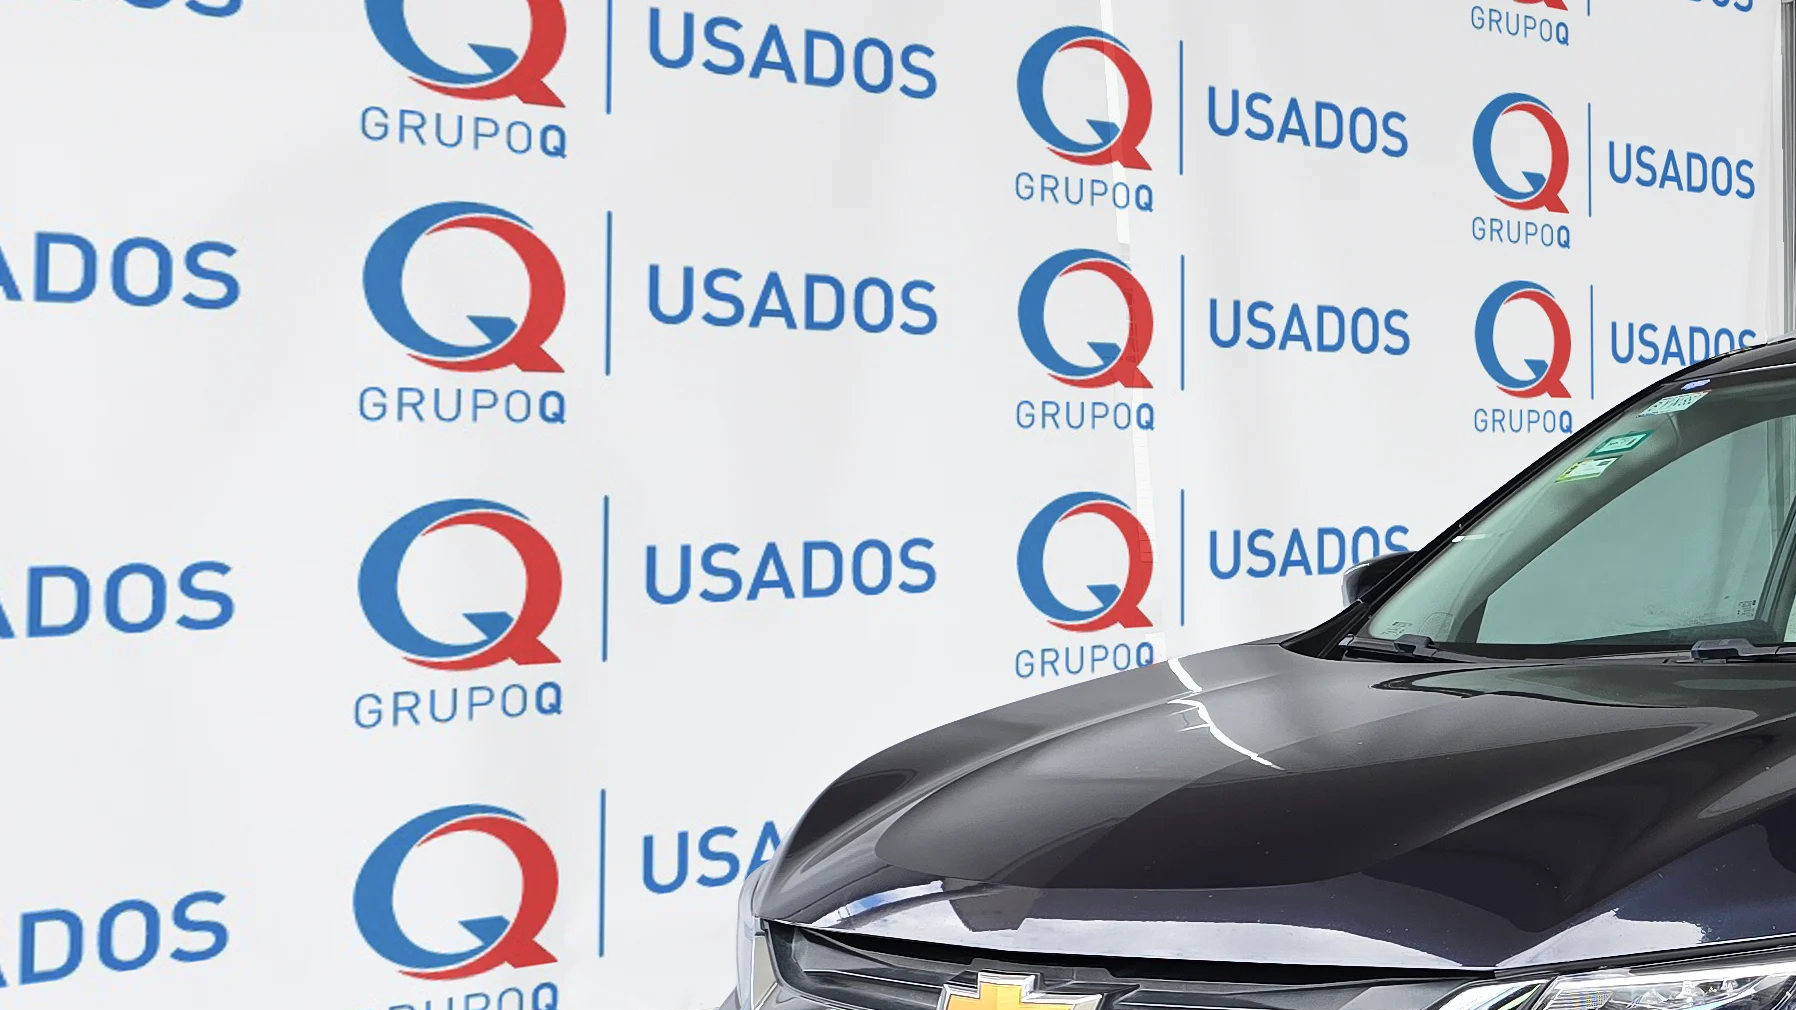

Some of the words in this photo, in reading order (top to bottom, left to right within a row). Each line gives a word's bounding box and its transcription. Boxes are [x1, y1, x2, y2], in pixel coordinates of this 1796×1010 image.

[649, 7, 938, 100] USADOS
[1471, 5, 1570, 46] GRUPOQ
[359, 105, 568, 160] GRUPOQ
[1207, 85, 1409, 158] USADOS
[1014, 171, 1154, 213] GRUPOQ
[1607, 139, 1756, 200] USADOS
[1471, 216, 1571, 249] GRUPOQ
[0, 230, 241, 311] DOS
[647, 263, 938, 336] USADOS
[1208, 297, 1411, 356] USADOS
[358, 386, 567, 425] GRUPOQ
[1016, 399, 1155, 431] GRUPOQ
[1473, 408, 1573, 434] GRUPOQ
[0, 559, 236, 639] DOS
[644, 536, 937, 606] USADOS
[1015, 641, 1155, 678] GRUPOQ
[354, 680, 563, 729] GRUPOQ
[641, 819, 783, 895] USA
[0, 889, 230, 987] DOS
